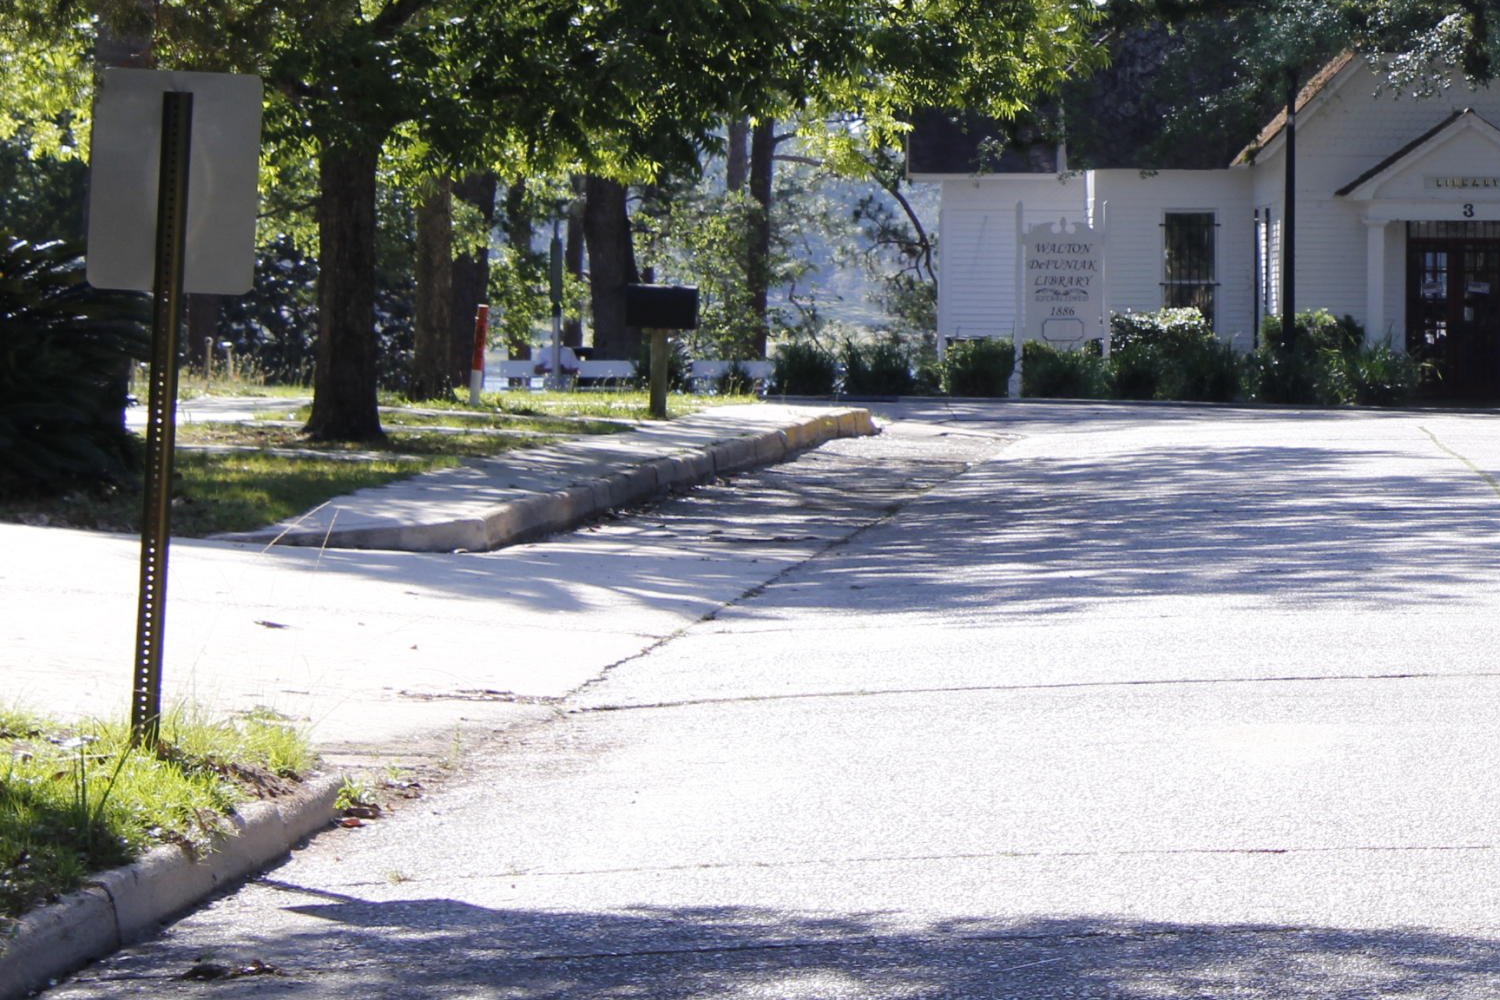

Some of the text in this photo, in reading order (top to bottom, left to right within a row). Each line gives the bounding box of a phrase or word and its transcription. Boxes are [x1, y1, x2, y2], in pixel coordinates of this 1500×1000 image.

[1463, 203, 1474, 218] 3
[1034, 242, 1092, 254] WALTON
[1034, 275, 1093, 287] LIBRARY
[1050, 306, 1075, 317] 1886
